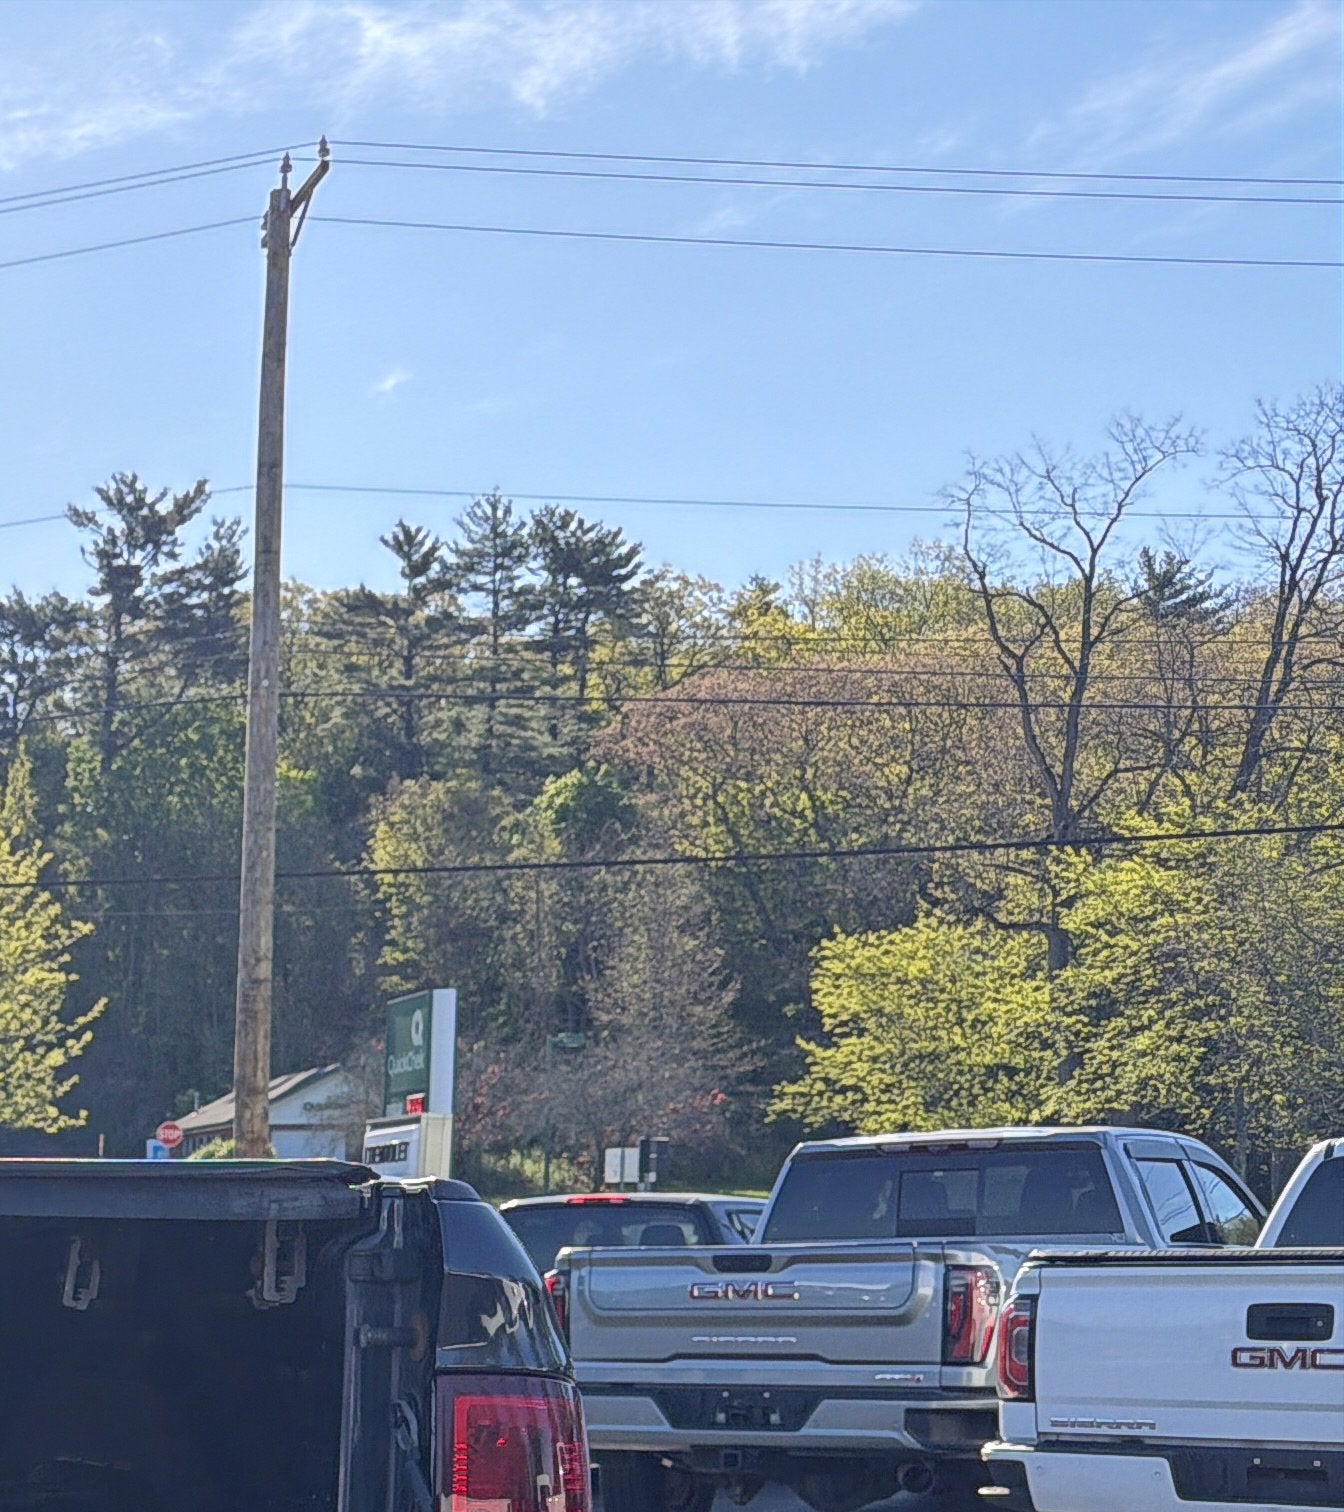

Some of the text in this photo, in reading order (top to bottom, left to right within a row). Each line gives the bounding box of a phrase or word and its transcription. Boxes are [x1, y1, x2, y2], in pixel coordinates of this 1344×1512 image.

[160, 1128, 181, 1140] STOP
[689, 1281, 800, 1300] GMC
[1231, 1346, 1344, 1370] GMC
